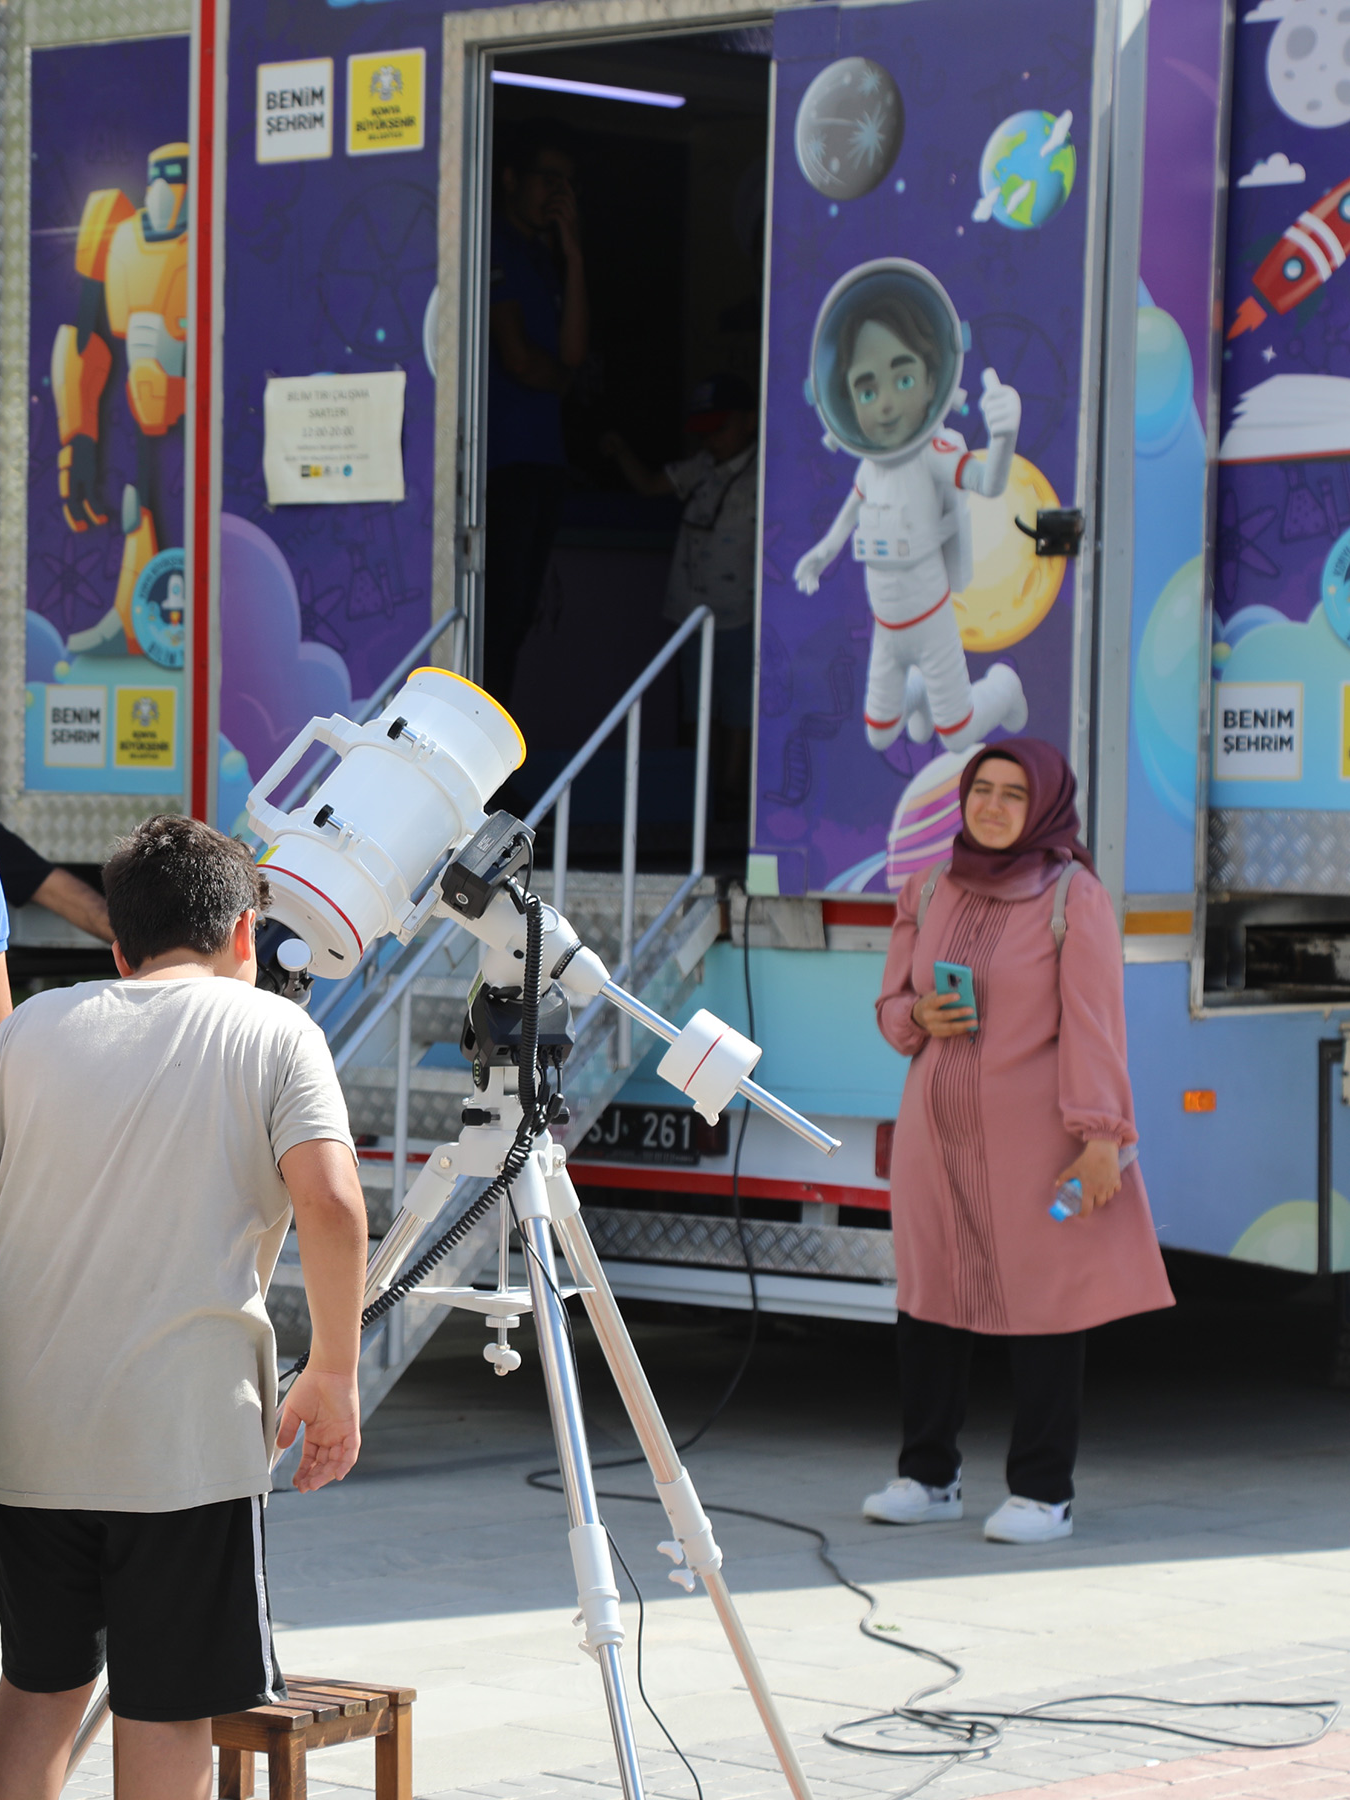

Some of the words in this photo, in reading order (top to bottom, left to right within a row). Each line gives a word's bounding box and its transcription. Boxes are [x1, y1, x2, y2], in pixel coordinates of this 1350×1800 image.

[266, 85, 325, 110] BENİM
[266, 111, 325, 136] ŞEHRİM
[52, 707, 101, 724] BENİM
[1223, 707, 1295, 730] BENİM
[51, 728, 101, 746] ŞEHRİM
[1223, 734, 1295, 755] ŞEHRİM
[642, 1112, 692, 1149] 261
